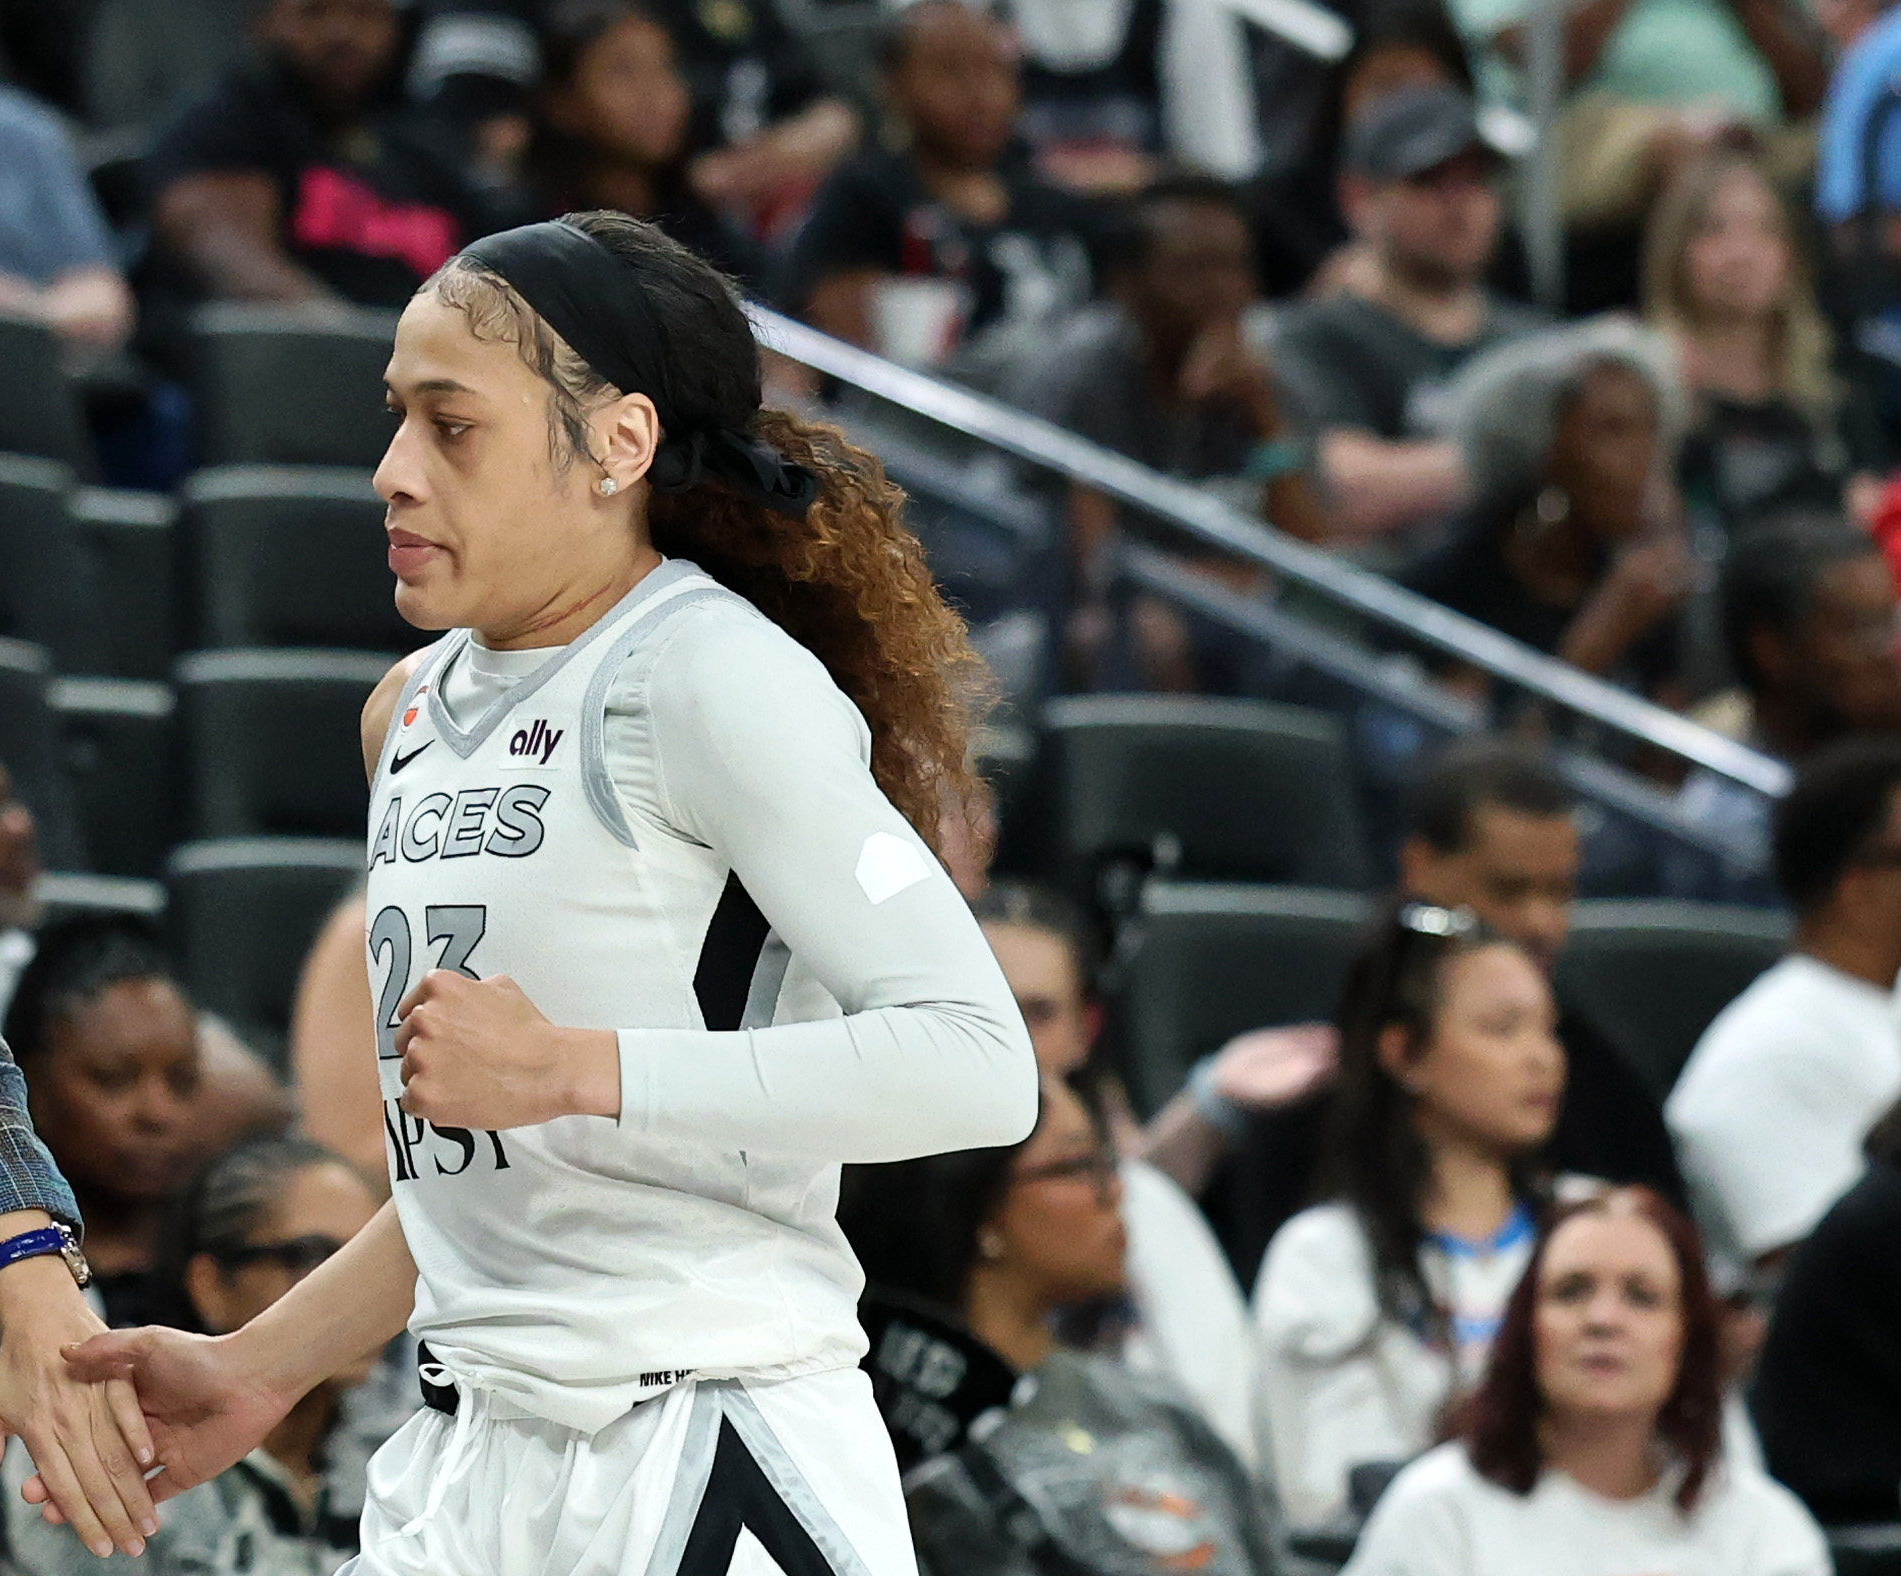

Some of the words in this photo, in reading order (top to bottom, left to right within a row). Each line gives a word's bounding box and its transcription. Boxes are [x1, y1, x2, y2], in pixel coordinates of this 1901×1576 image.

[509, 719, 565, 765] ally
[368, 784, 553, 871] ACES
[639, 1370, 673, 1387] NIKE
